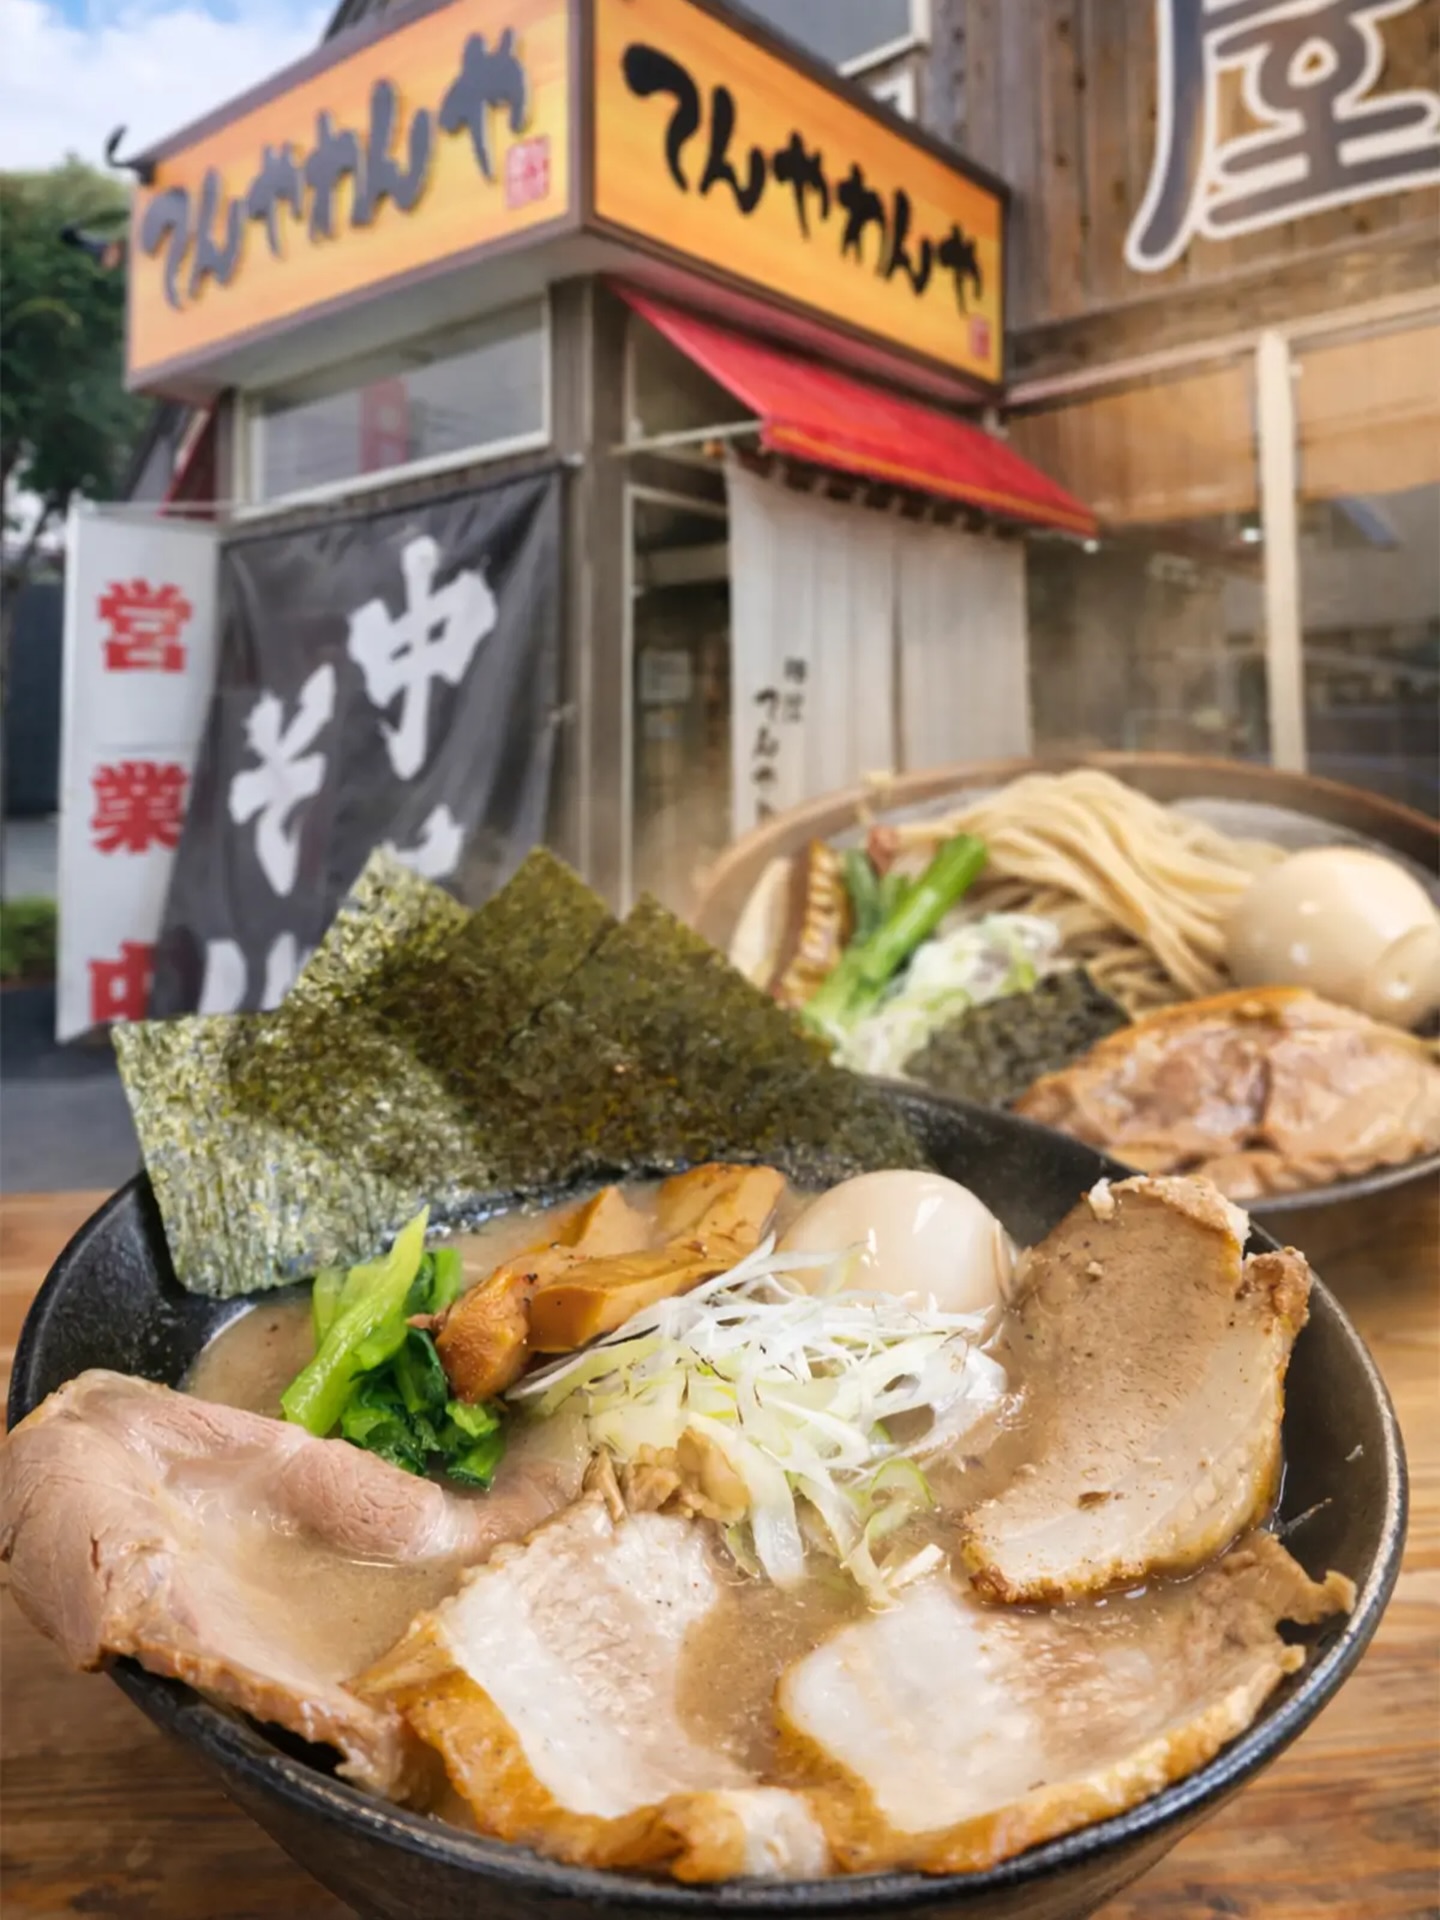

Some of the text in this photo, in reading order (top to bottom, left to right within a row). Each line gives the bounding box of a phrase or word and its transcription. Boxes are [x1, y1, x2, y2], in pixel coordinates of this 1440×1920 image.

[142, 27, 528, 312] てんやわんや
[622, 43, 985, 320] てんやわんや
